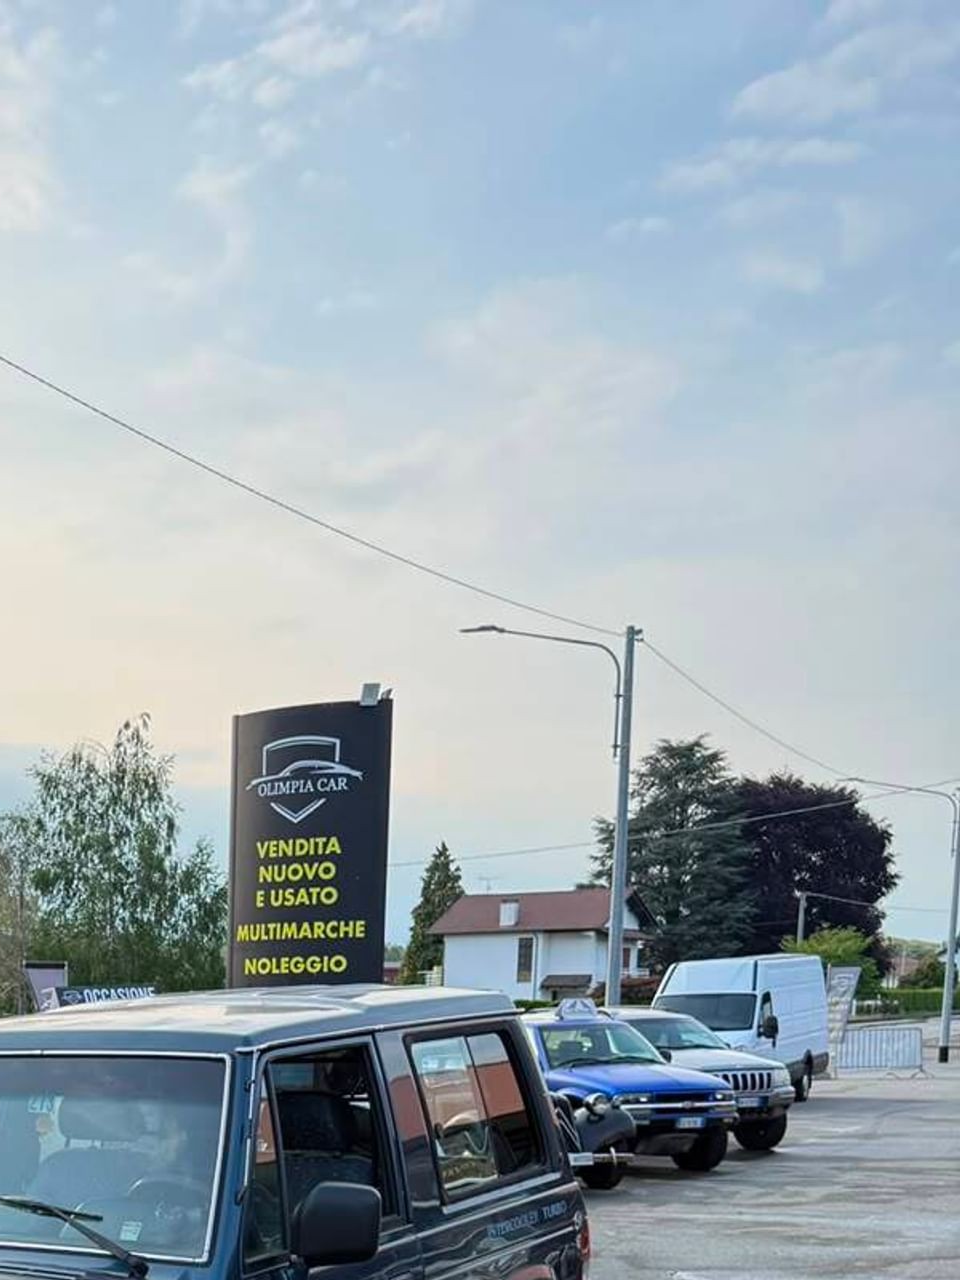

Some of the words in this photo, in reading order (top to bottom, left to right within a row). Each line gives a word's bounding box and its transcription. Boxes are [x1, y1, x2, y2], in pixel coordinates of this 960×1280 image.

[258, 780, 314, 797] OLIMPIA
[317, 777, 348, 792] CAR
[256, 836, 342, 859] VENDITA
[258, 861, 337, 883] NUOVO
[255, 892, 265, 908] E
[270, 886, 339, 908] USATO
[236, 920, 367, 942] MULTIMARCHE
[244, 955, 348, 976] NOLEGGIO
